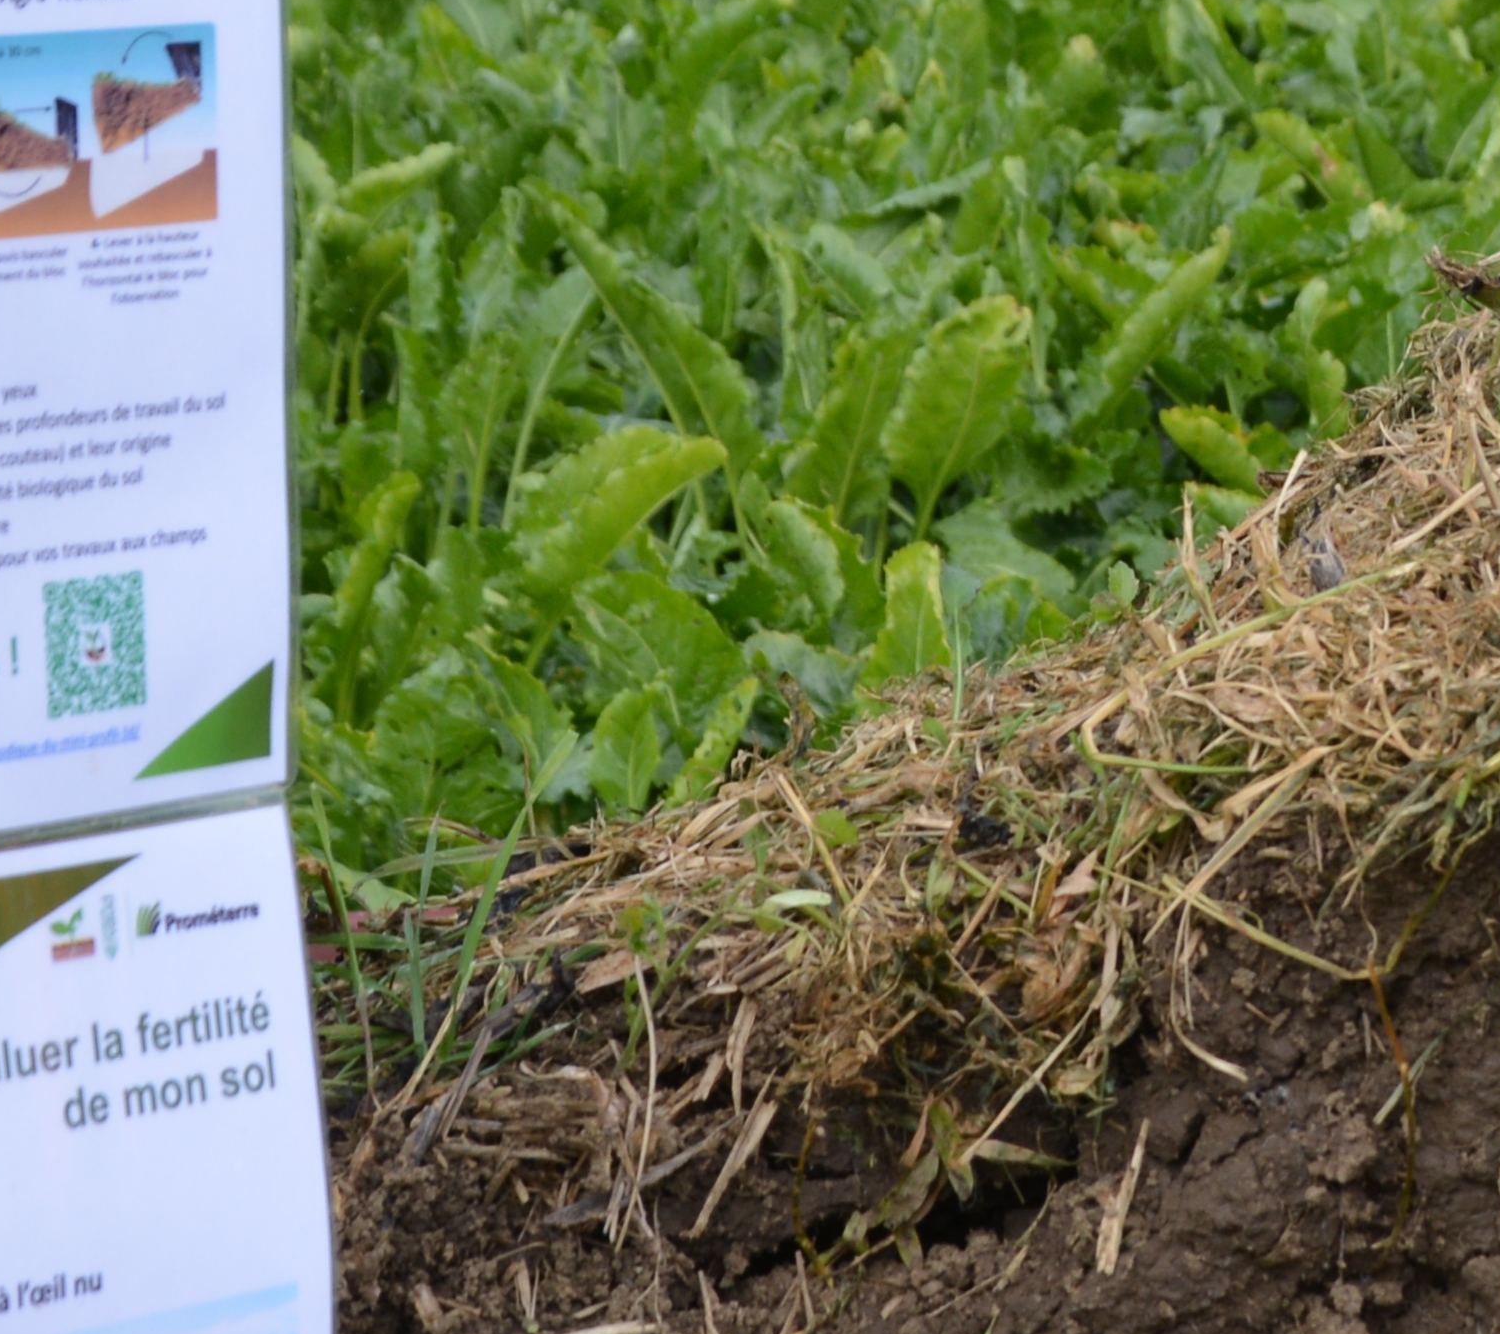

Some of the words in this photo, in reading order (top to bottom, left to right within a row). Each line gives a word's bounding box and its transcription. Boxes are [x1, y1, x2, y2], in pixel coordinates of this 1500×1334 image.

[2, 384, 37, 403] yeux
[0, 444, 64, 468] couteau)
[70, 443, 82, 460] et
[88, 440, 115, 457] leur
[121, 434, 171, 455] origine
[18, 476, 94, 499] biologique
[100, 471, 117, 488] du
[123, 467, 142, 486] sol
[34, 546, 57, 563] vos
[63, 540, 115, 559] travaux
[121, 536, 145, 551] aux
[151, 528, 206, 547] champs
[10, 637, 19, 675] !
[165, 903, 259, 934] Prométerre
[92, 1023, 125, 1064] la
[137, 990, 269, 1054] fertilité
[63, 1087, 110, 1130] de
[124, 1075, 207, 1118] mon
[221, 1050, 276, 1098] sol
[18, 1278, 67, 1308] l'œil
[74, 1273, 101, 1296] nu
